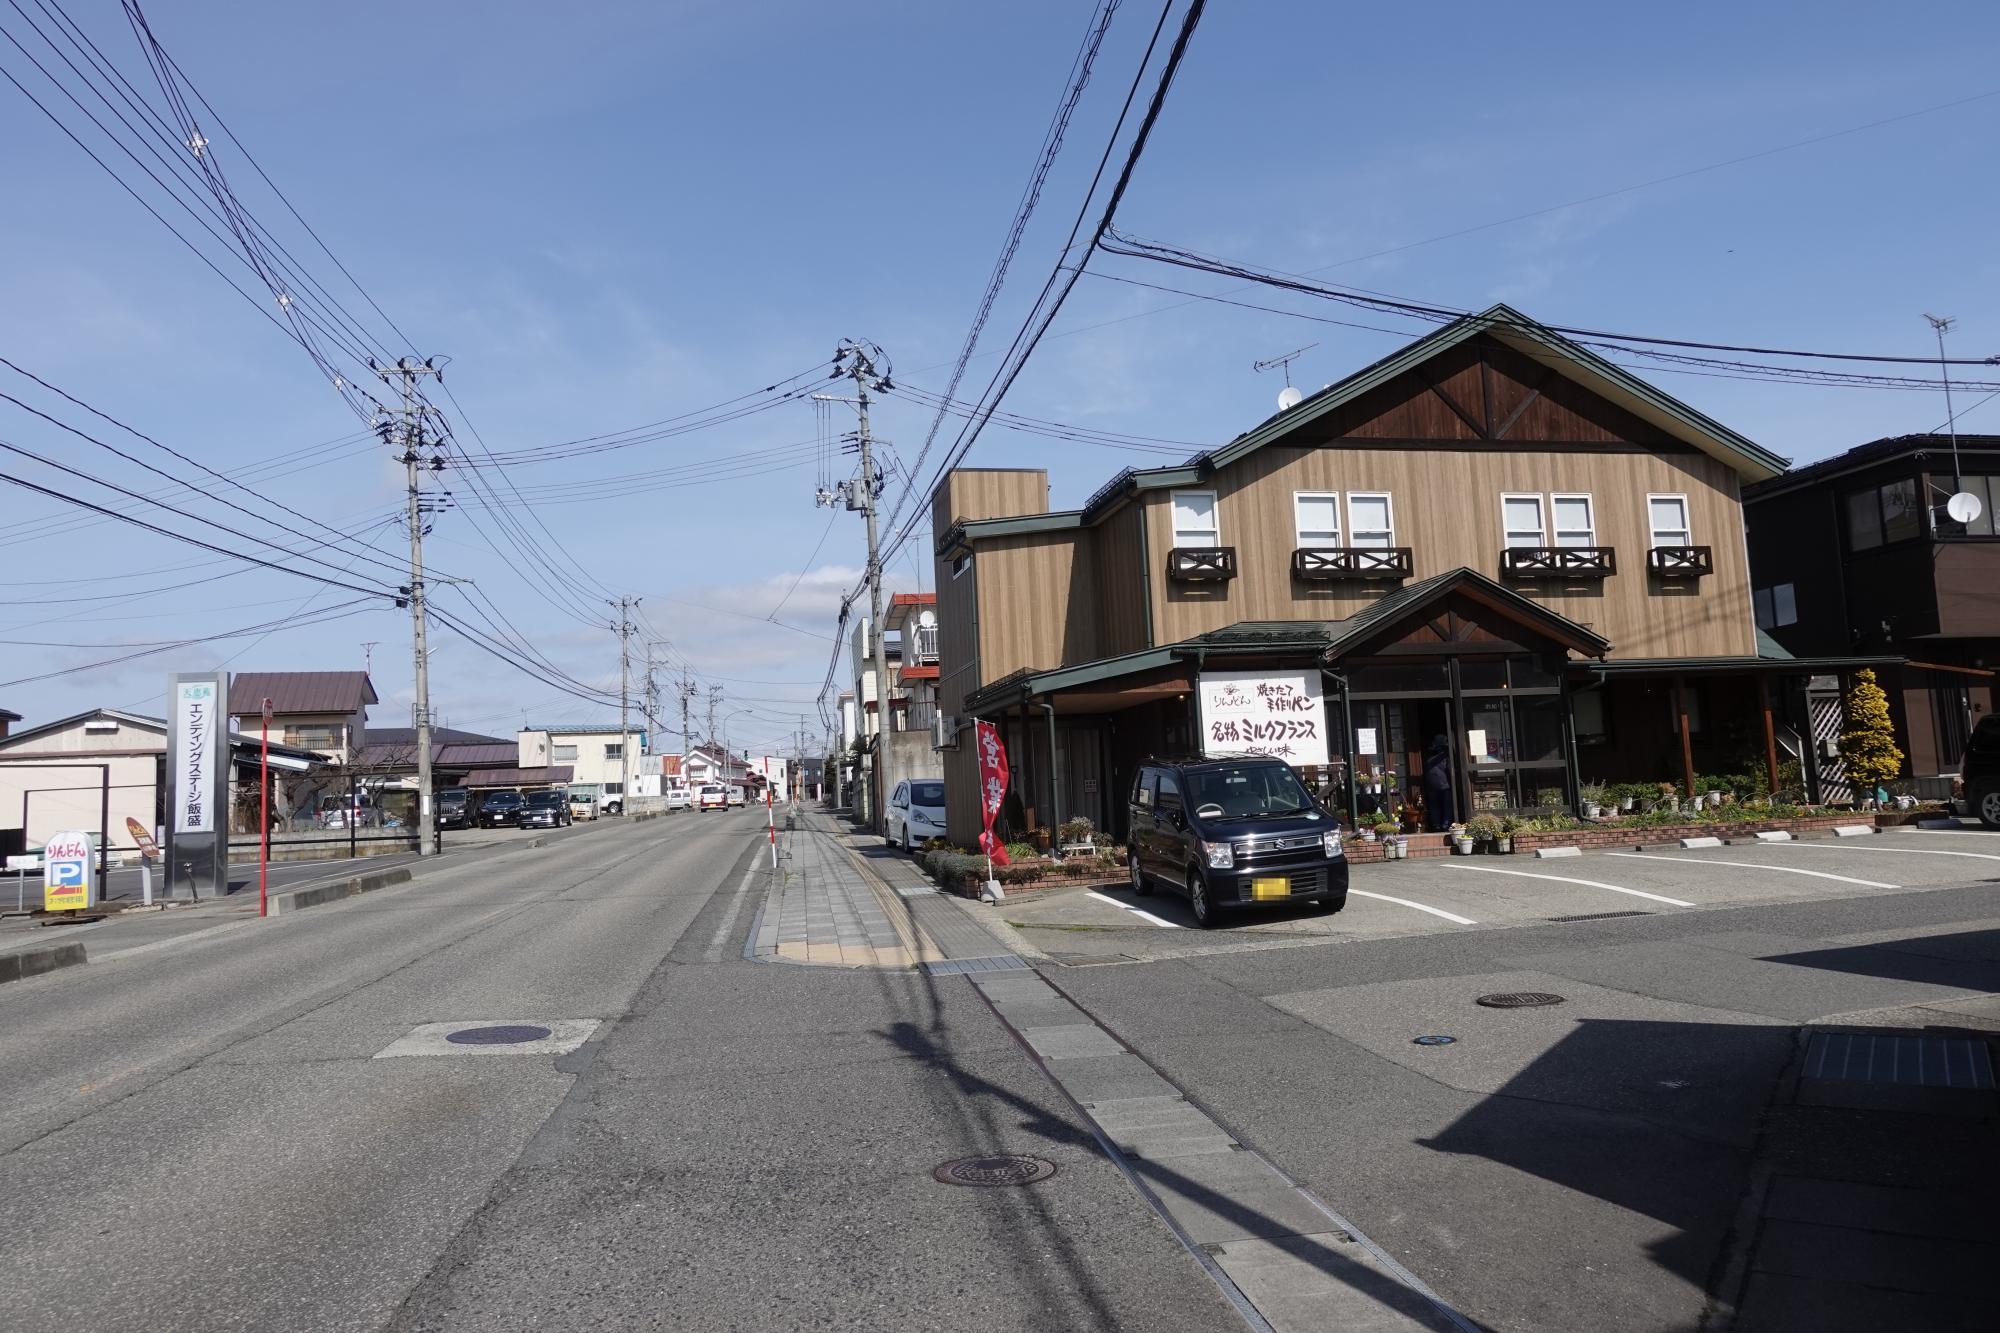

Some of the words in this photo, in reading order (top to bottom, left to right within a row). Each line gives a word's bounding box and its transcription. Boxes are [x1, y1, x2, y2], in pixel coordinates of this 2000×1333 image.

[1257, 683, 1293, 696] 焼きたて
[1214, 695, 1251, 708] りんどん
[1267, 696, 1315, 712] 手作りパン
[187, 703, 203, 826] エンディングステージ飯盛
[48, 843, 86, 859] りんどん
[52, 863, 80, 885] P
